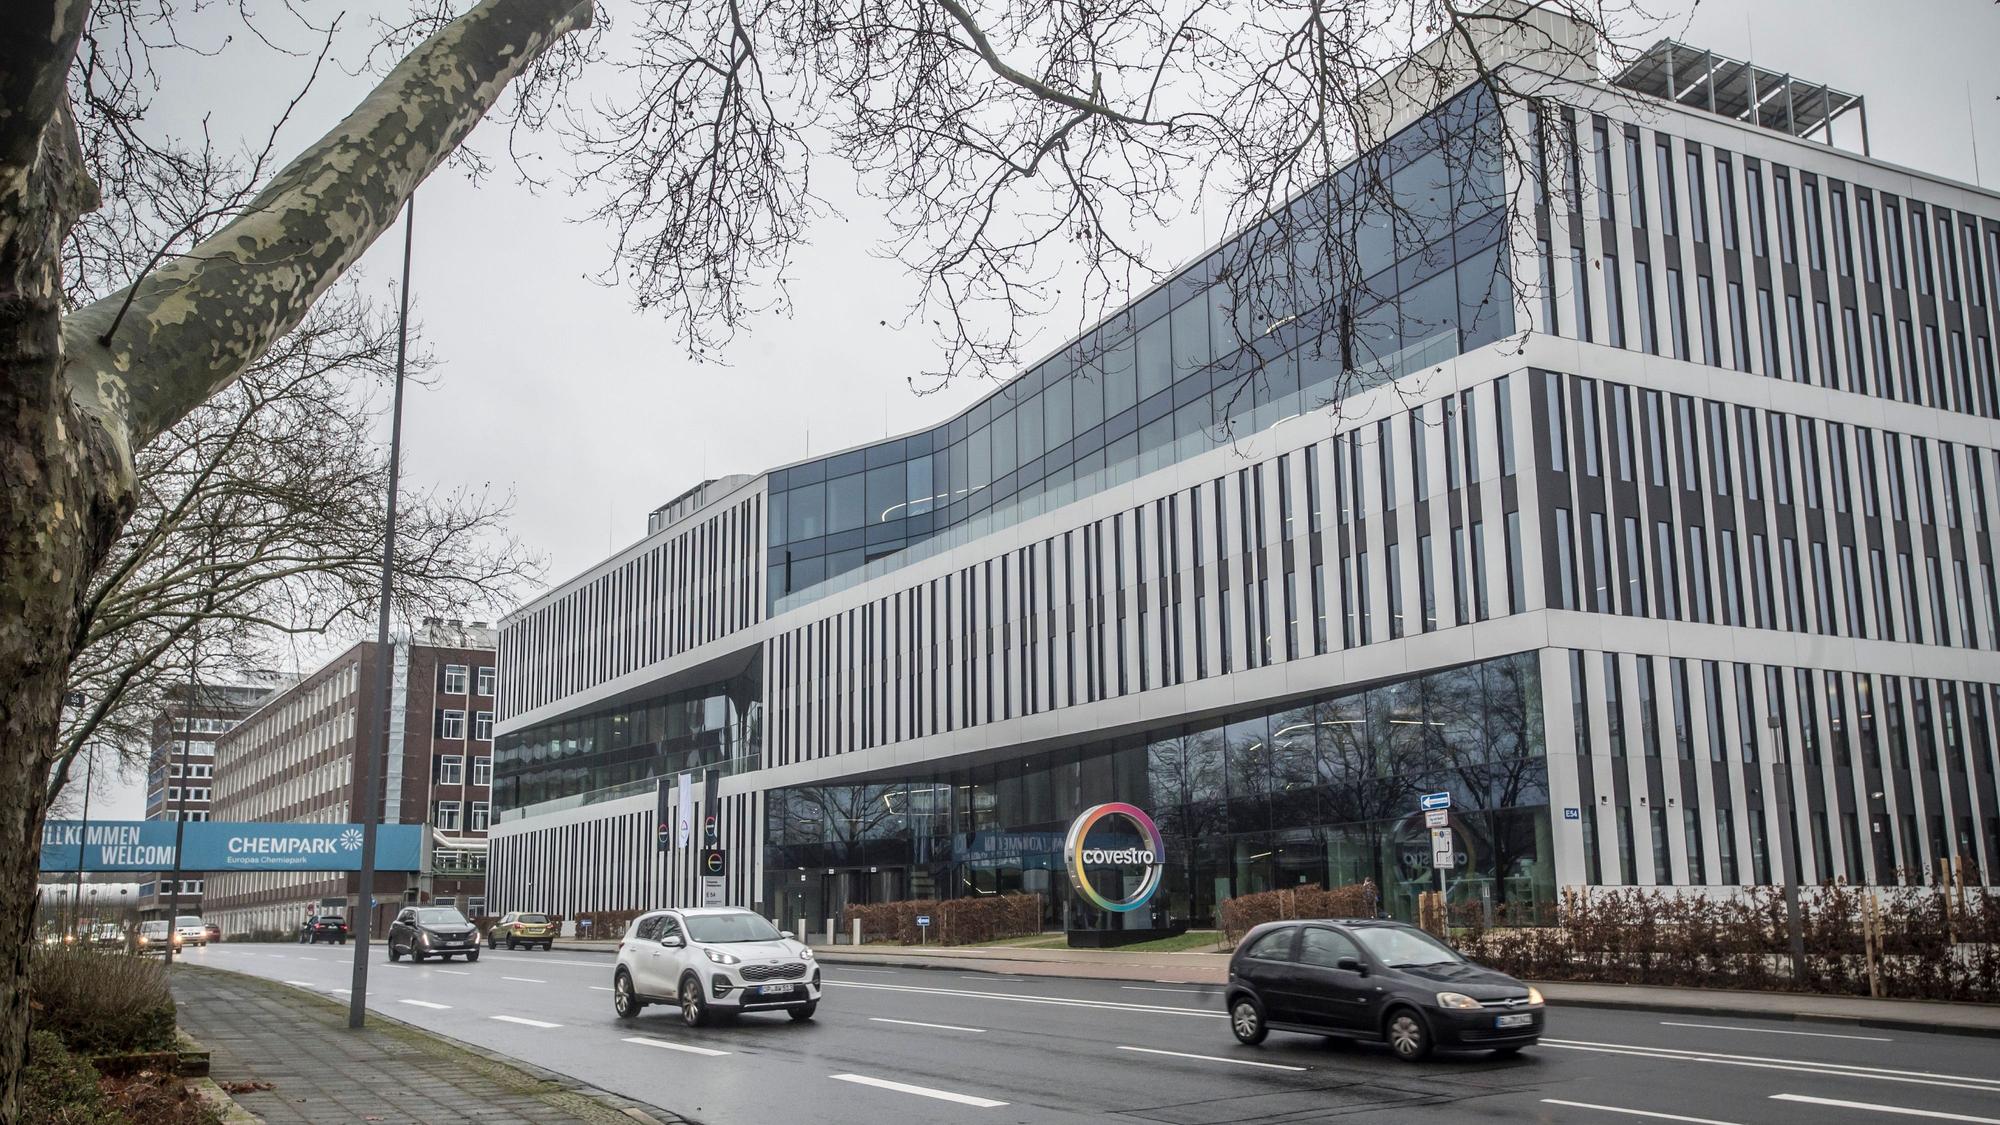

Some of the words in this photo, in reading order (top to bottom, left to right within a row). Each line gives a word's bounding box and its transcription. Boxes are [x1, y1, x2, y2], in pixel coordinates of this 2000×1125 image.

[1565, 809, 1578, 818] E54
[42, 825, 141, 846] ILLKOMMEN
[228, 837, 338, 854] CHEMPARK
[227, 856, 260, 864] Europas
[260, 856, 308, 864] Chemiepark
[1082, 848, 1154, 865] covestro
